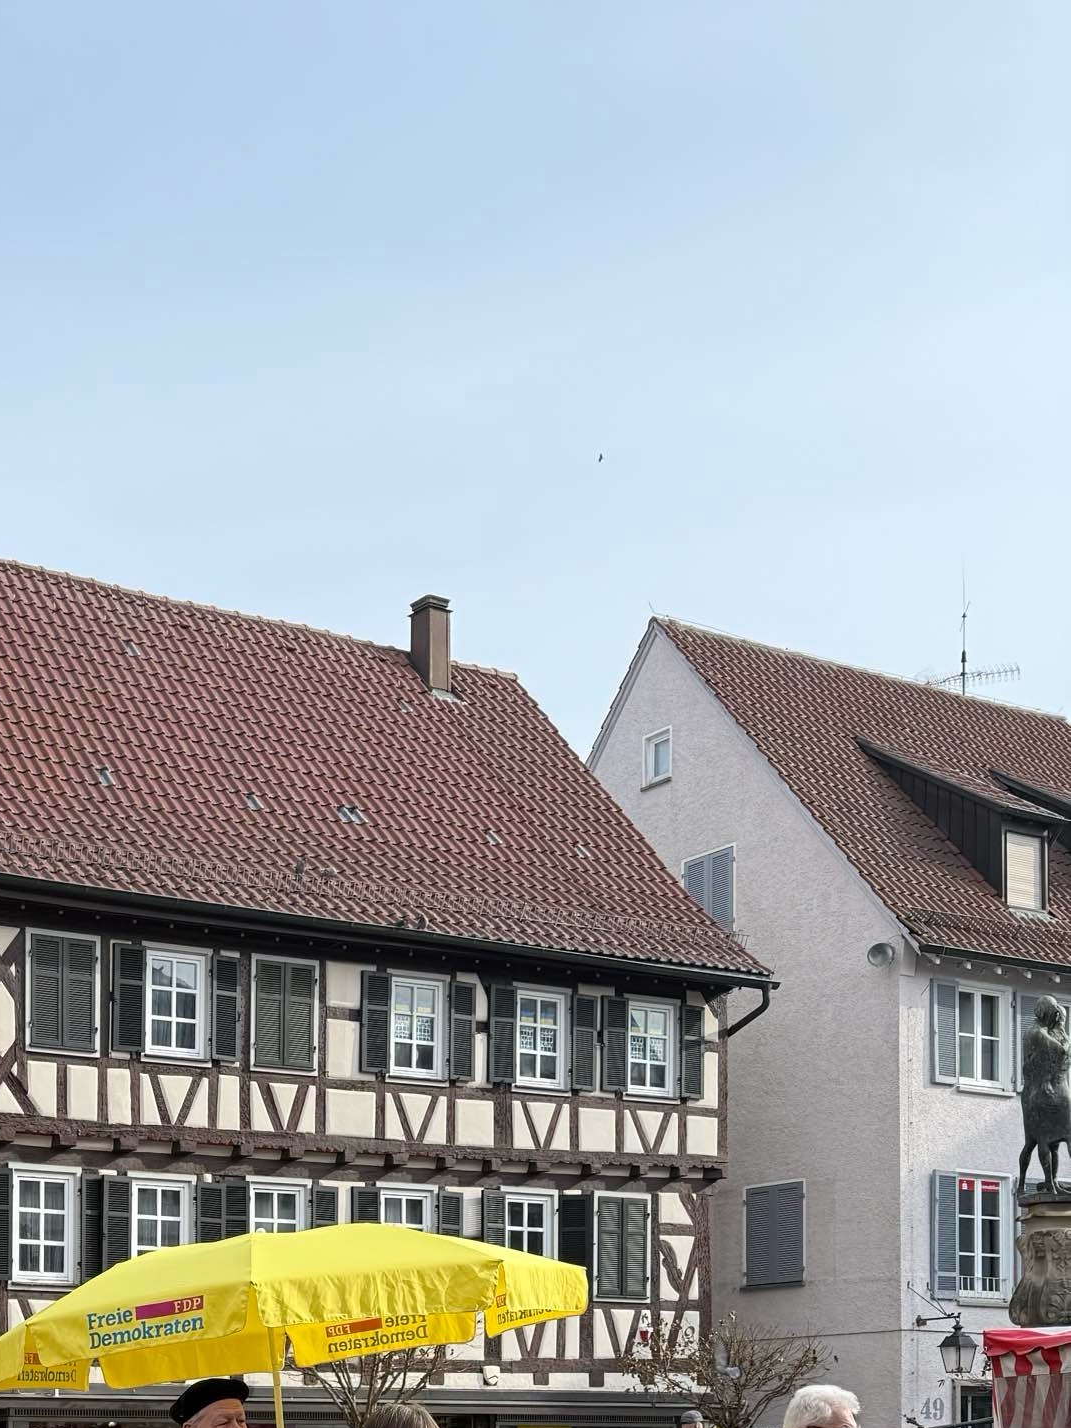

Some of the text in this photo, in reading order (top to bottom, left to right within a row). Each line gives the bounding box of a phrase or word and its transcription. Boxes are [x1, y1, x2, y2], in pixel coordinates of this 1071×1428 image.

[86, 1297, 202, 1331] Freie FDP
[89, 1316, 205, 1350] Demokraten
[920, 1397, 945, 1421] 49
